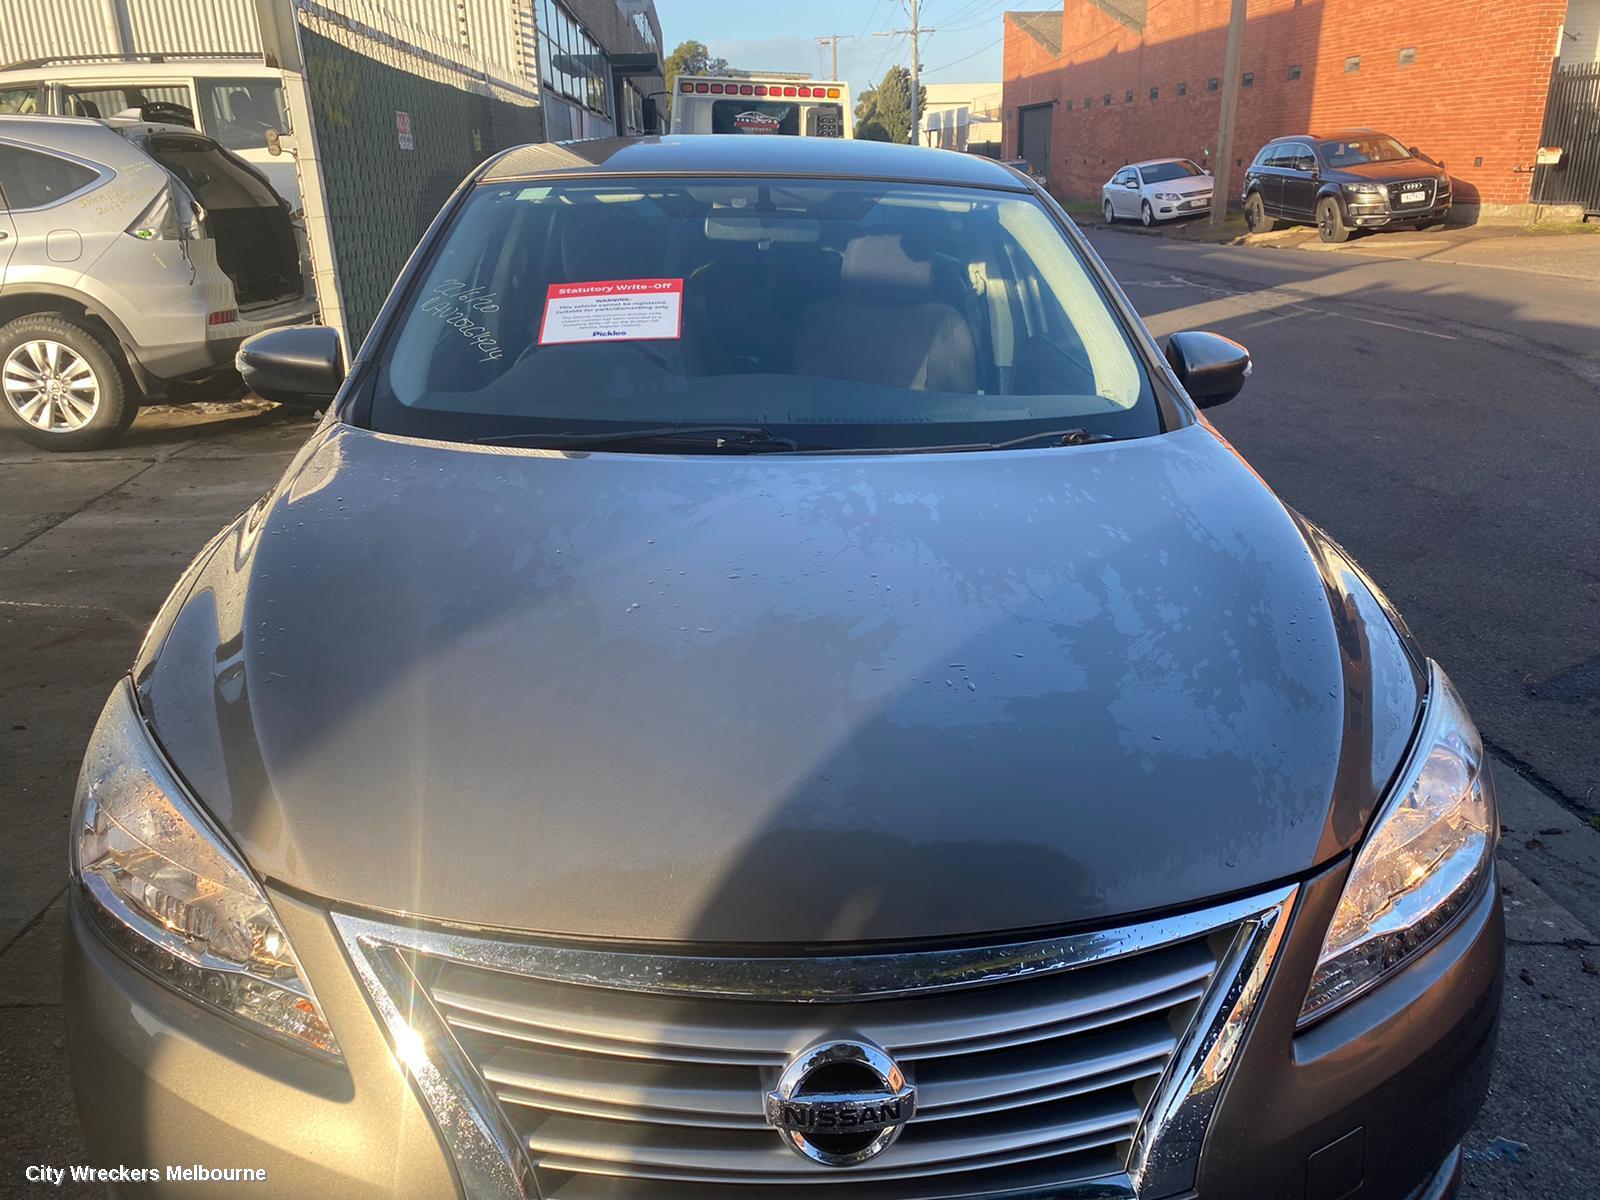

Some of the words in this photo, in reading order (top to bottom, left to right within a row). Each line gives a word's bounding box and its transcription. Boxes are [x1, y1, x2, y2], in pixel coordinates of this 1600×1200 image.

[559, 286, 613, 295] Statutory
[616, 283, 672, 291] Write-Off
[16, 324, 65, 336] MICHELIN
[784, 1103, 901, 1128] NISSAN
